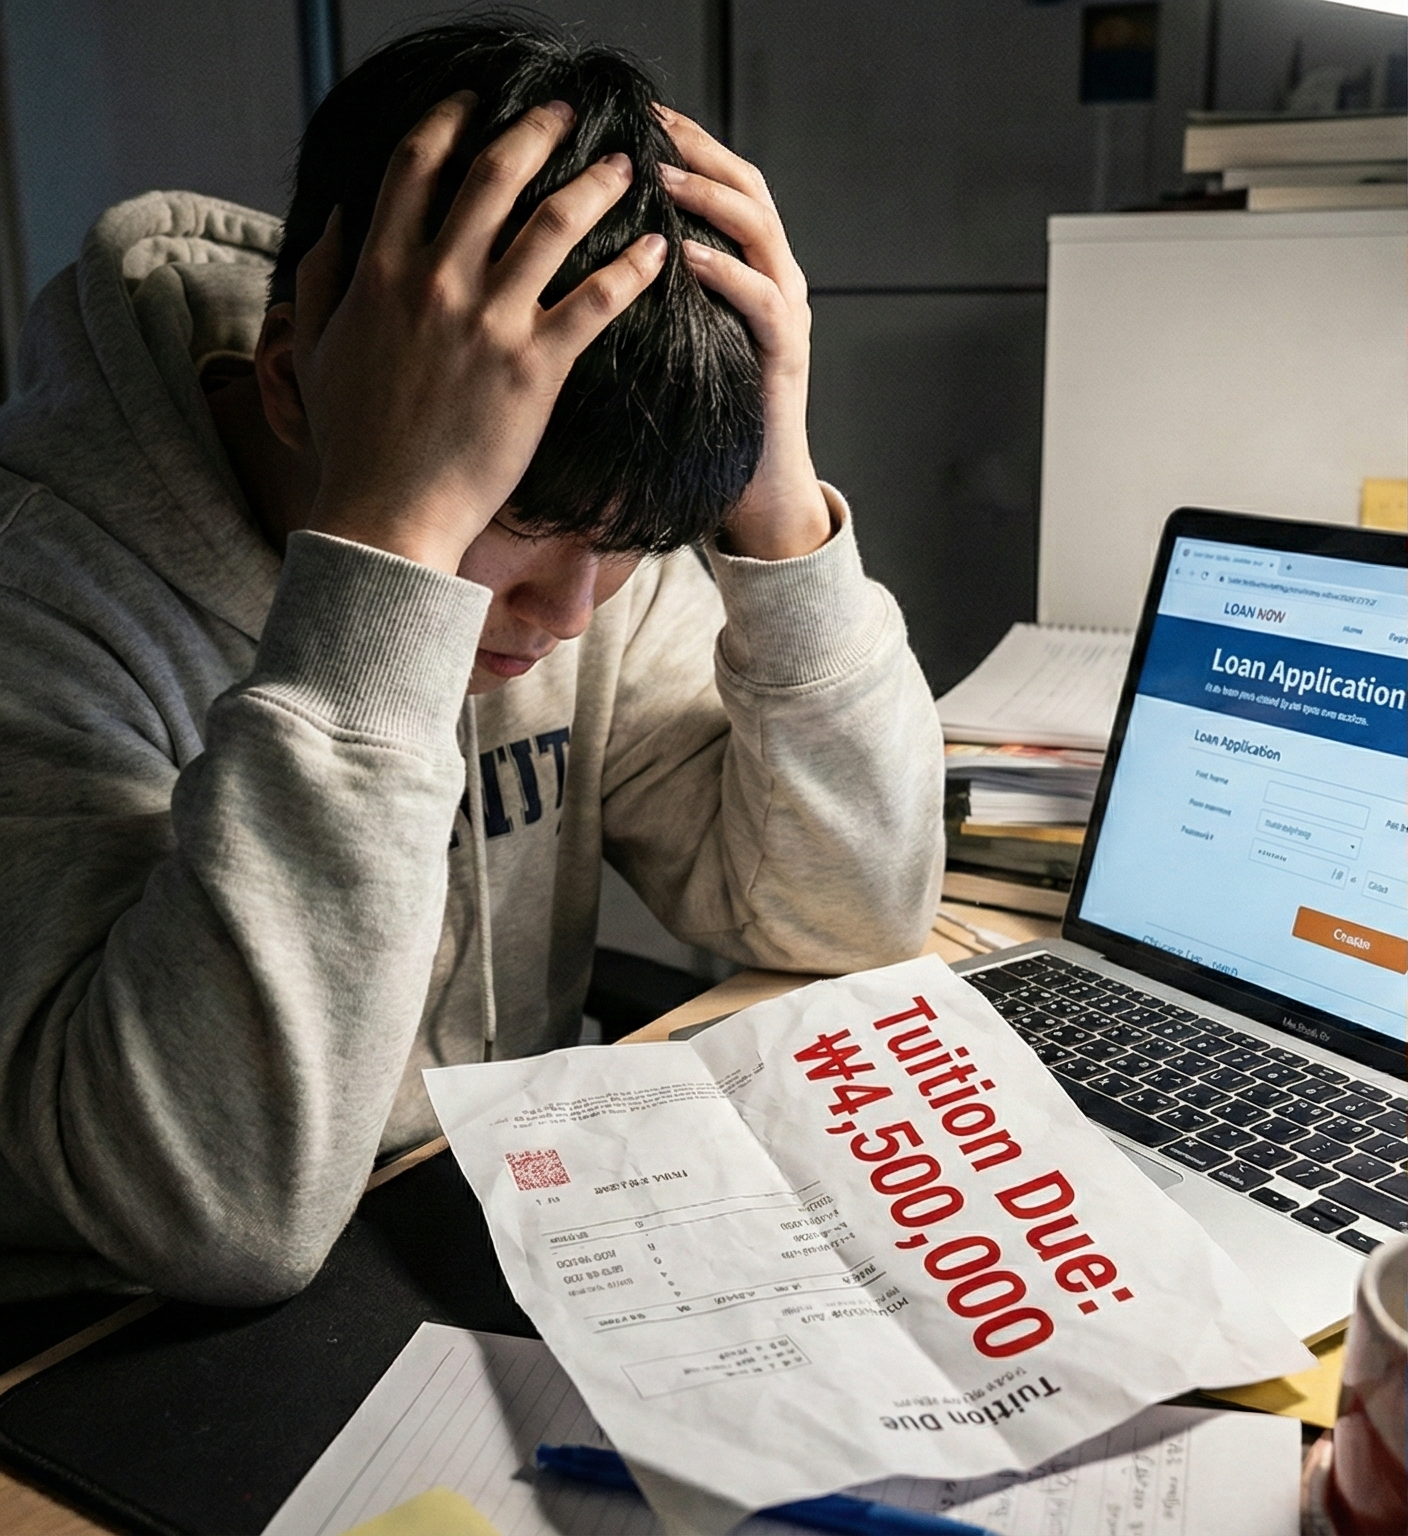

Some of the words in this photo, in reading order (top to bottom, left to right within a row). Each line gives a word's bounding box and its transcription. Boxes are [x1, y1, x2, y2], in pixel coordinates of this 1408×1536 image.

[1224, 602, 1256, 619] LOAN
[1256, 607, 1287, 623] NOW
[1212, 648, 1266, 681] Loan
[1269, 660, 1406, 710] Application
[1195, 729, 1219, 746] Loan
[1220, 736, 1281, 761] Application
[874, 996, 1021, 1171] Tuition
[997, 1171, 1131, 1313] Due:
[794, 1030, 1053, 1358] ₩4,500,000
[879, 1413, 944, 1433] Due
[947, 1375, 1062, 1427] Tuition
